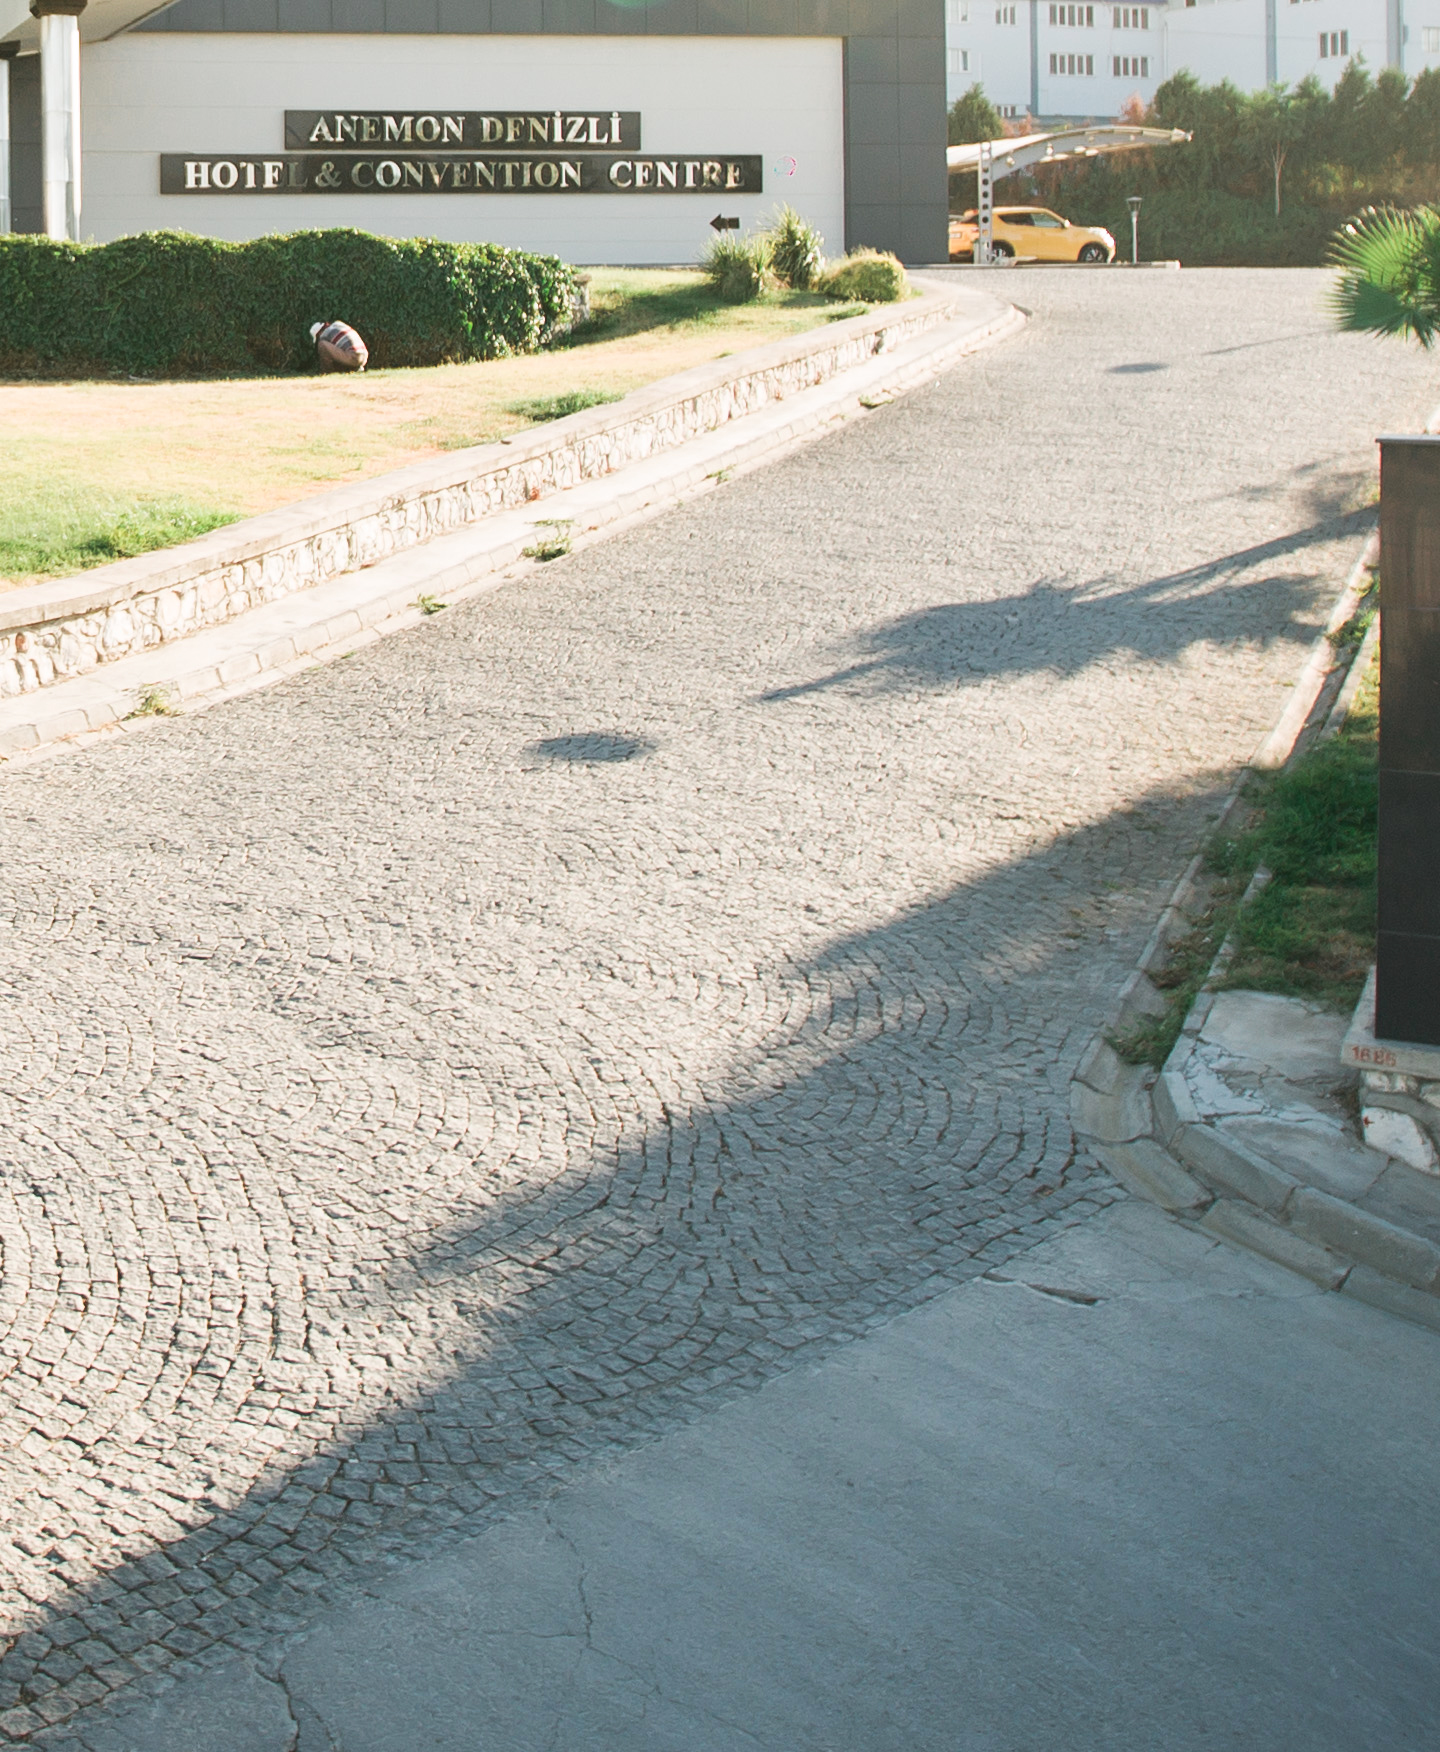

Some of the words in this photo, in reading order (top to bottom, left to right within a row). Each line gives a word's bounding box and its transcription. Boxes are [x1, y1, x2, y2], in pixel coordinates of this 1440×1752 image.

[309, 115, 466, 143] ANEMON
[480, 110, 622, 144] DENİZLİ
[184, 160, 308, 189] HOTEL
[315, 161, 342, 188] &
[351, 160, 583, 188] CONVENTION
[609, 160, 745, 189] CENTRE
